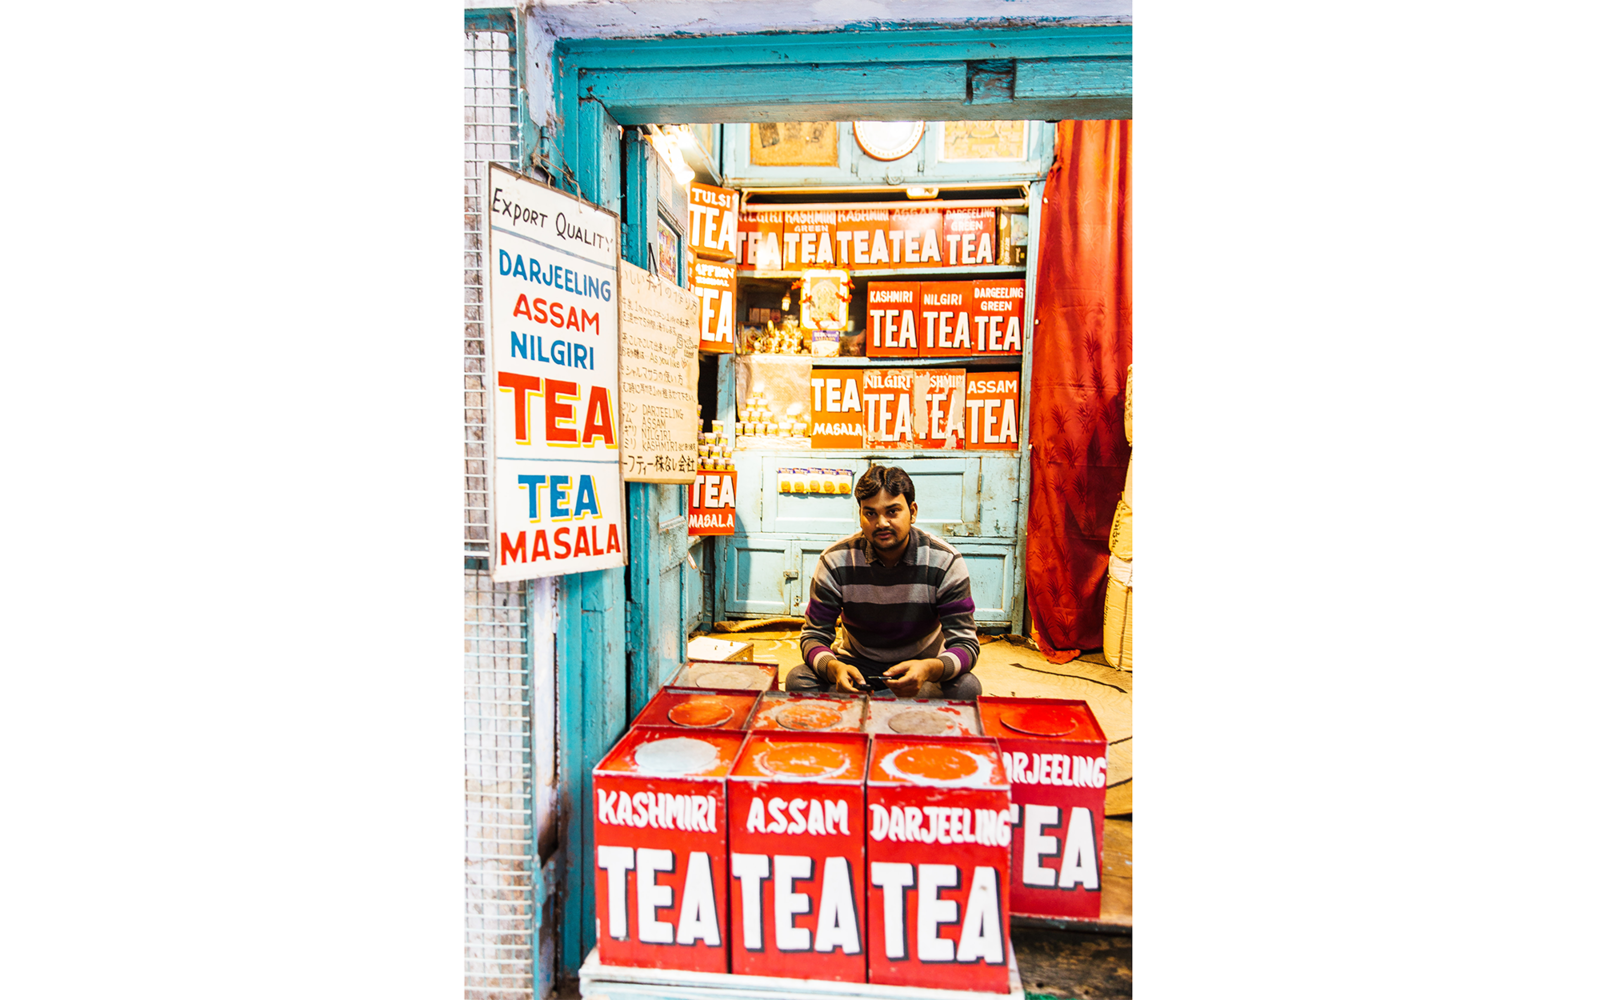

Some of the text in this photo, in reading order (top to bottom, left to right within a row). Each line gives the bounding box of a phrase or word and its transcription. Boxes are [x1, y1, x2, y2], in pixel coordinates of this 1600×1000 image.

[692, 187, 732, 209] TULSI
[690, 203, 736, 255] TEA
[794, 224, 829, 232] GREEN
[951, 219, 983, 231] GREEN
[784, 232, 835, 264] TEA
[836, 229, 889, 264] TEA
[889, 229, 942, 263] TEA
[946, 232, 994, 265] TEA
[498, 249, 612, 302] DARJEELING
[974, 287, 1024, 299] DARGEELING
[512, 293, 600, 336] ASSAM
[869, 291, 913, 303] KASHMIRI
[924, 294, 962, 306] NILGIRI
[980, 301, 1013, 311] GREEN
[869, 309, 918, 348] TEA
[923, 311, 971, 348] TEA
[974, 316, 1021, 351] TEA
[510, 331, 595, 371] NILGIRI
[811, 378, 862, 413] TEA
[968, 380, 1017, 394] ASSAM
[498, 371, 618, 449] TEA
[641, 416, 666, 430] ASSAM
[642, 403, 685, 420] DARJEELING
[864, 394, 913, 443] TEA
[966, 399, 1018, 444] TEA
[641, 428, 672, 442] NILGIRI
[642, 440, 678, 453] KASHMIRI
[812, 422, 863, 436] MASALA
[518, 473, 603, 523] TEA
[693, 475, 736, 509] TEA
[688, 514, 735, 528] MASALA
[500, 523, 621, 566] MASALA
[1002, 751, 1108, 788] ARJEELING
[597, 788, 718, 833] KASHMIRI
[746, 797, 851, 836] ASSAM
[869, 803, 1012, 847] DARJEELING
[597, 845, 722, 947] TEA
[731, 853, 863, 957] TEA
[871, 862, 1007, 966] TEA
